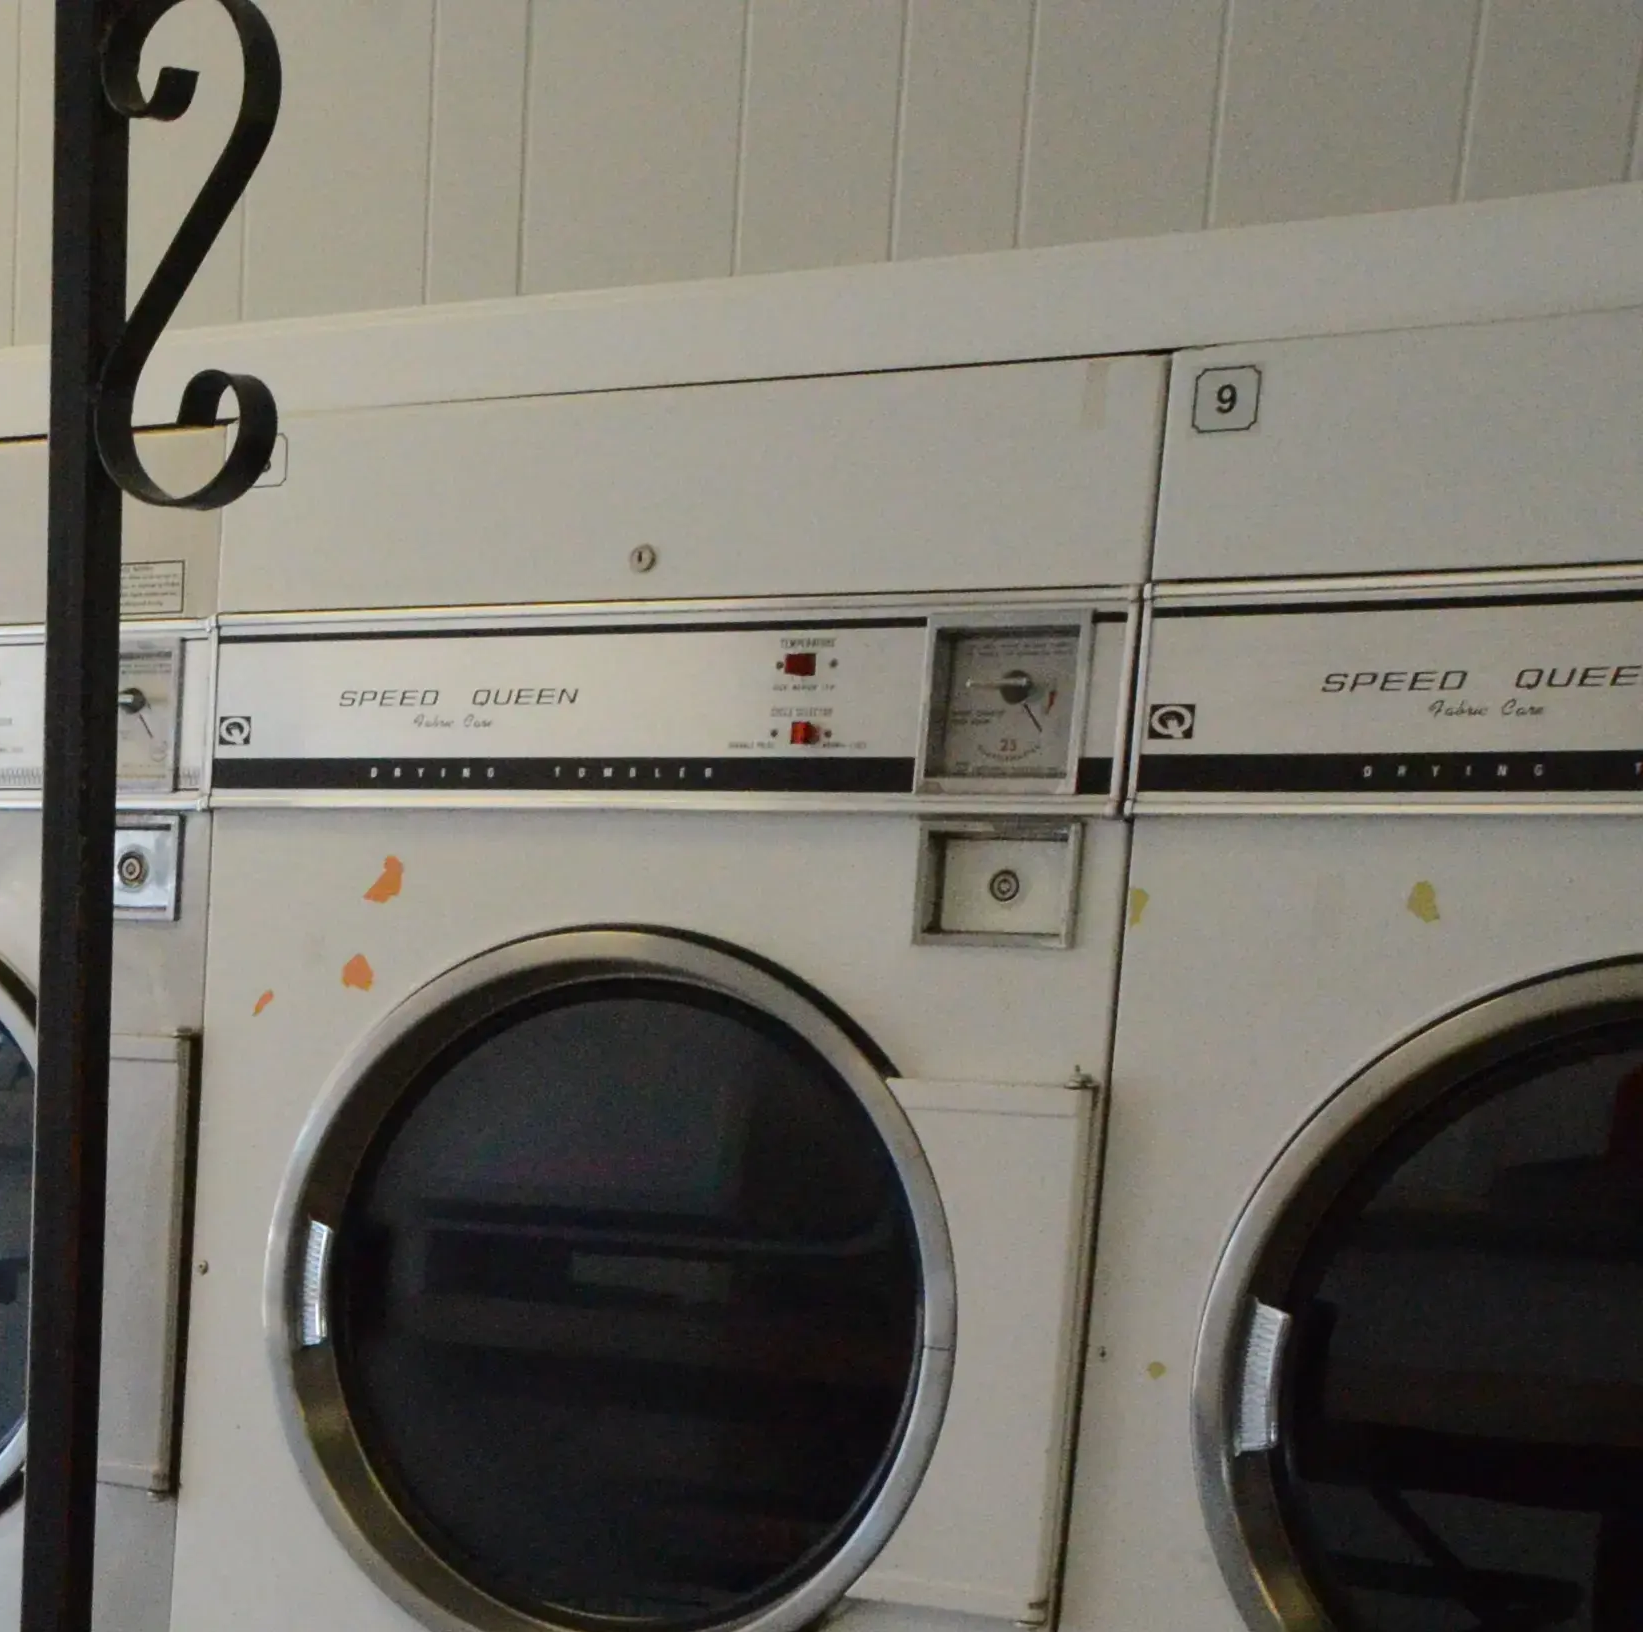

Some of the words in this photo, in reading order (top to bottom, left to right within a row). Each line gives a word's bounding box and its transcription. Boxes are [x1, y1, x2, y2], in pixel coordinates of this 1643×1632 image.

[1216, 383, 1237, 414] 9
[1321, 670, 1467, 693] SPEED
[339, 689, 440, 707] SPEED
[471, 687, 579, 706] QUEEN
[1428, 699, 1488, 718] Fabric
[1501, 699, 1544, 717] Care
[370, 767, 495, 778] DRYING
[554, 766, 714, 778] TUMBLER
[1363, 763, 1544, 778] DRYING
